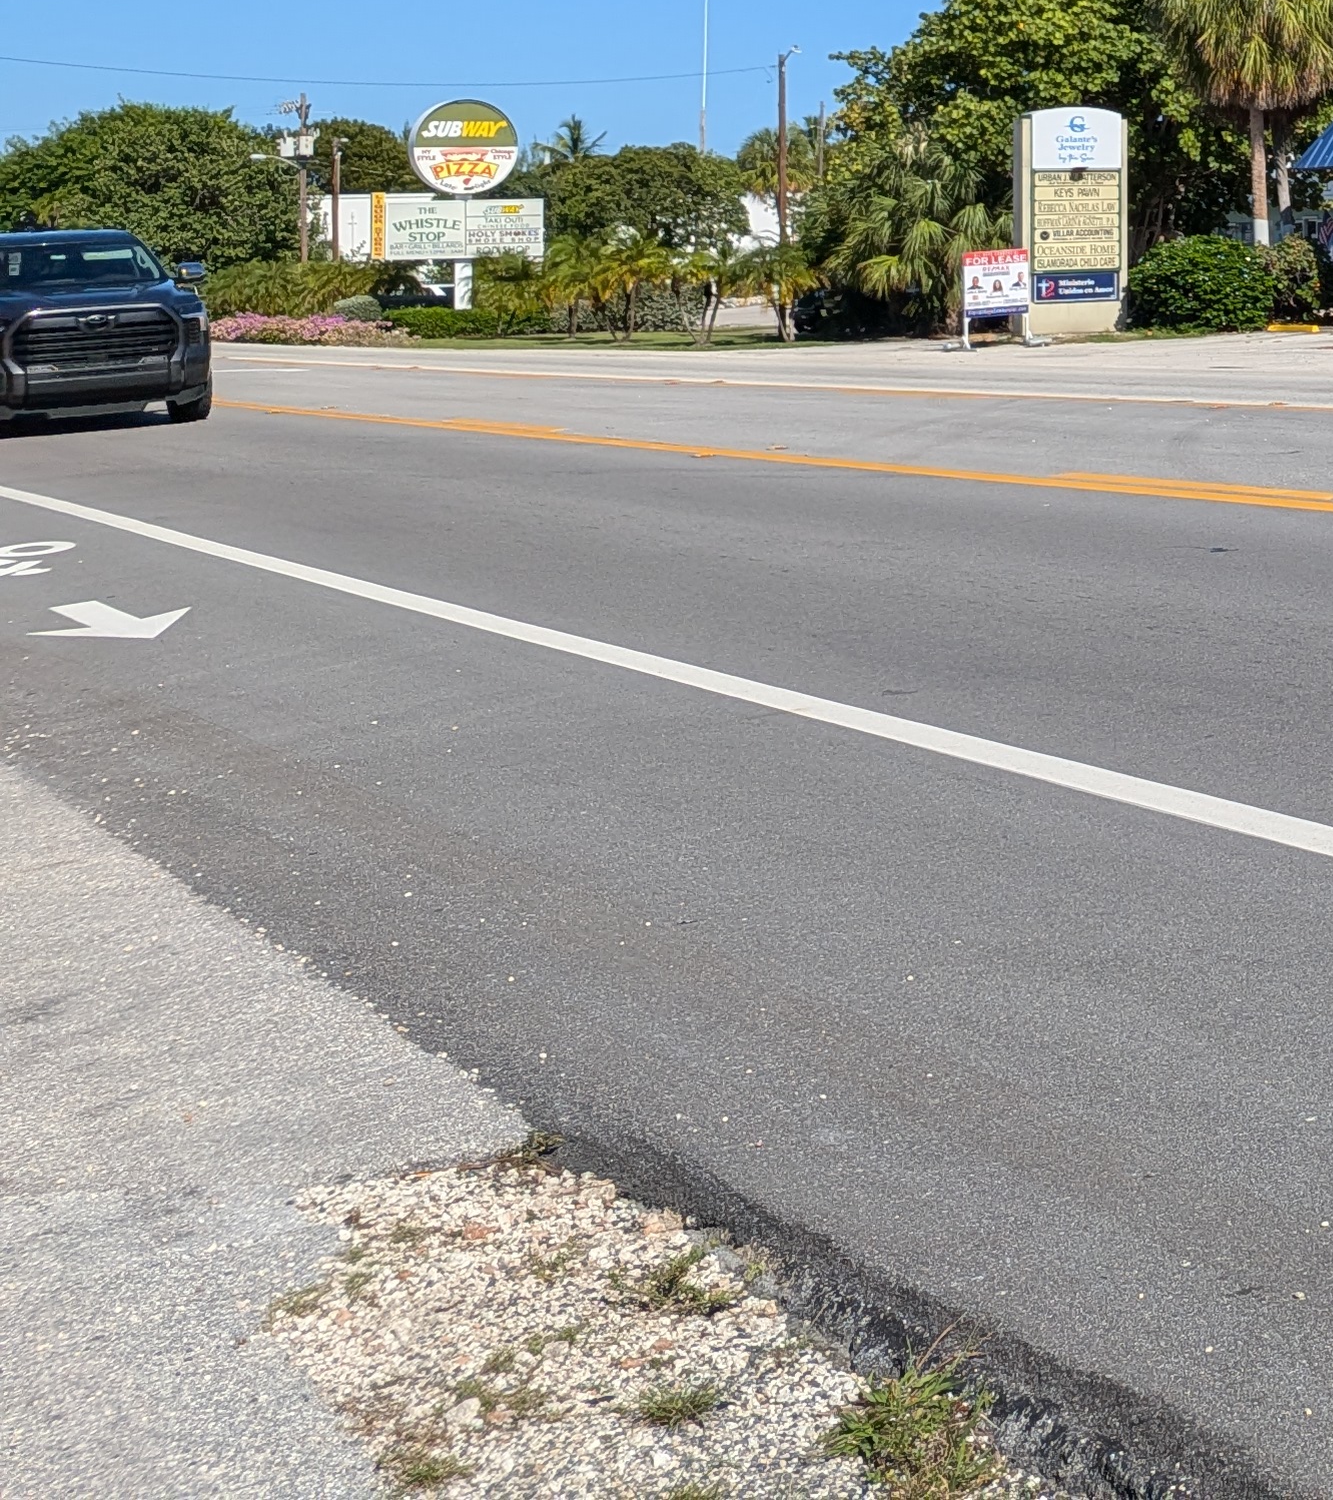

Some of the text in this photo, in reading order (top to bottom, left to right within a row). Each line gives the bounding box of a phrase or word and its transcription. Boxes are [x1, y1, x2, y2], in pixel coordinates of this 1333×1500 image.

[421, 120, 508, 138] SUBWAY
[1056, 135, 1098, 143] Galante's
[1058, 144, 1095, 152] Jewelry
[433, 162, 493, 178] PIZZA
[1053, 188, 1100, 197] KEYS PAWN
[483, 204, 525, 214] SUBWAY
[392, 218, 462, 232] WHISTLE
[408, 232, 446, 242] STOP
[1037, 244, 1116, 255] OCEANSIDE HOME
[965, 257, 988, 266] FOR
[992, 254, 1027, 264] LEASE
[1037, 257, 1116, 268] ISLAMORADA CHILD CARE
